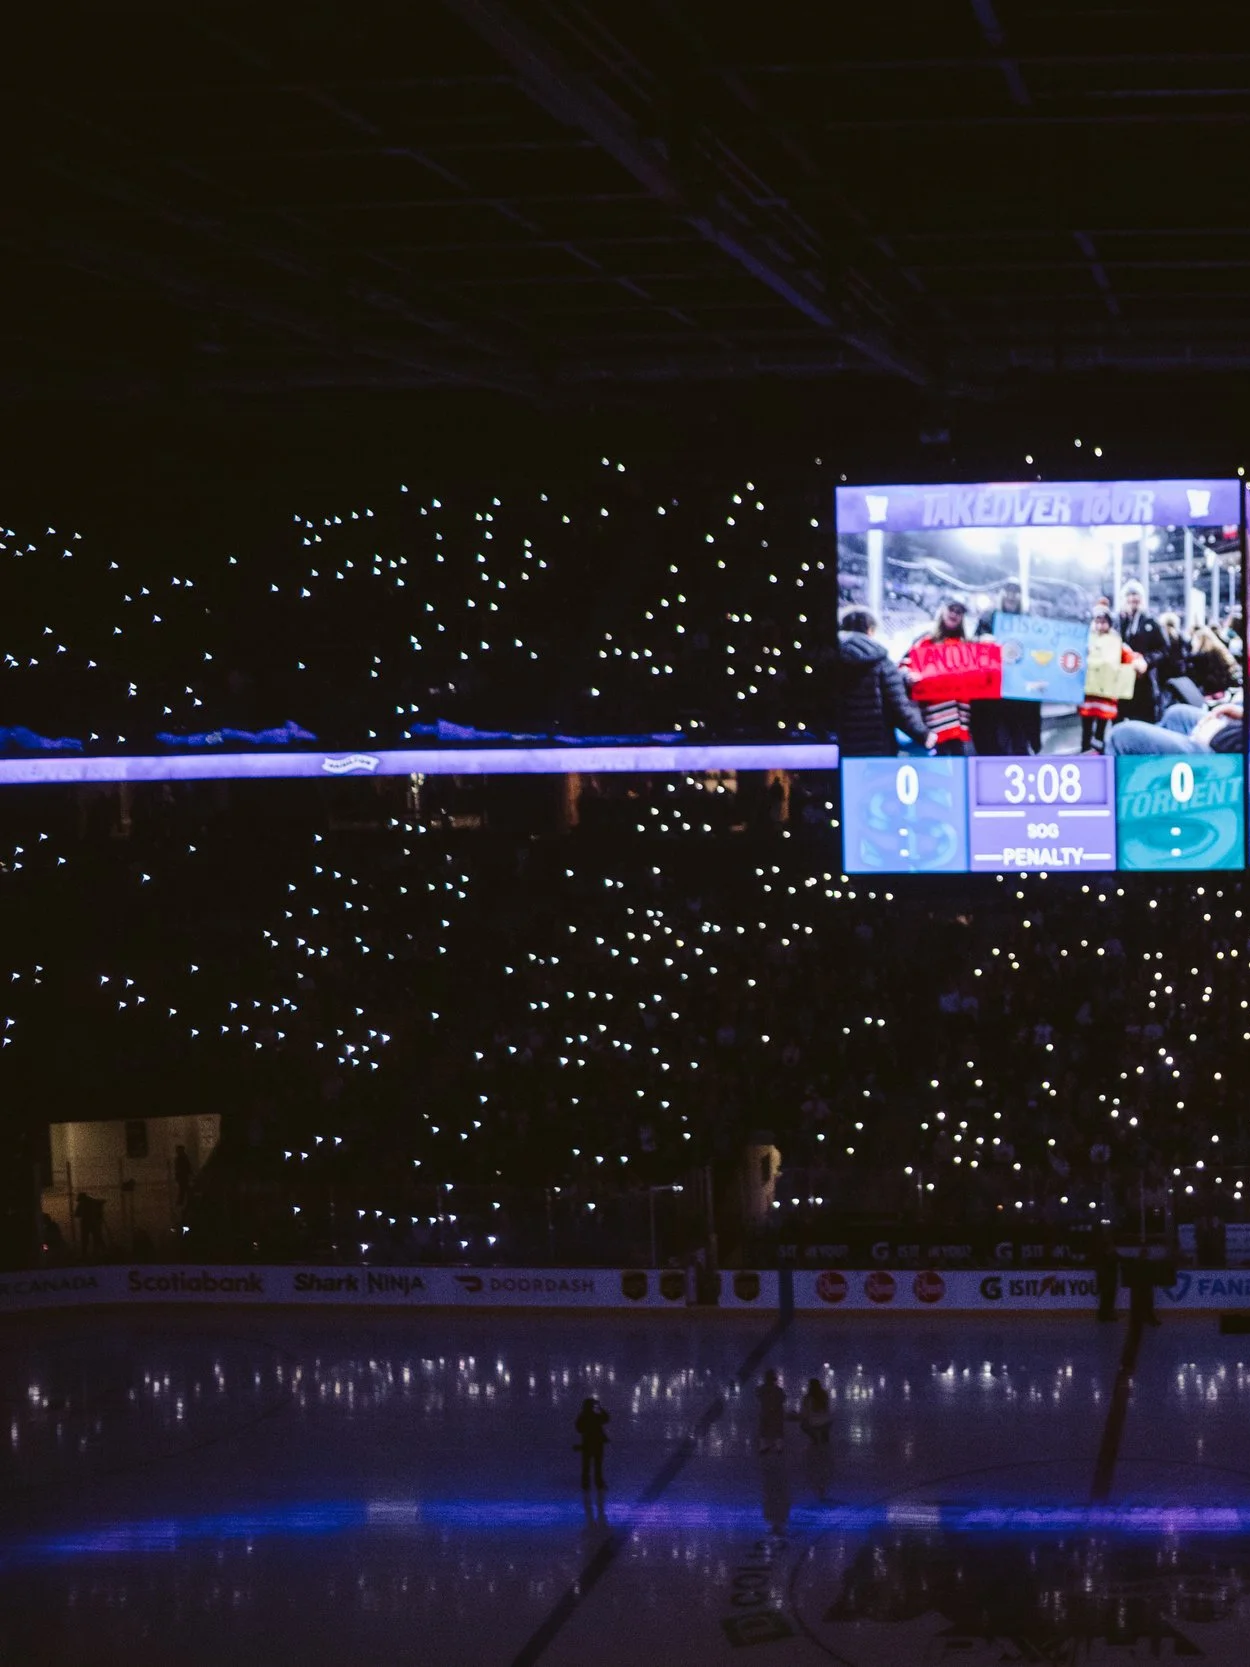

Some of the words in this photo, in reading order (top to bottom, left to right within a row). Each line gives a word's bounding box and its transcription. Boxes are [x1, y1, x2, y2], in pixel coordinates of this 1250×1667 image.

[922, 493, 1072, 526] TAKEOVER
[1081, 489, 1155, 523] TOUR
[896, 764, 919, 805] 0
[1004, 763, 1083, 804] 3:08
[1170, 762, 1194, 801] 0
[1027, 823, 1060, 839] SOG
[1003, 847, 1084, 867] PENALTY
[128, 1270, 264, 1293] Scotiabank
[294, 1272, 359, 1292] Shark
[490, 1278, 595, 1293] DOORDASH
